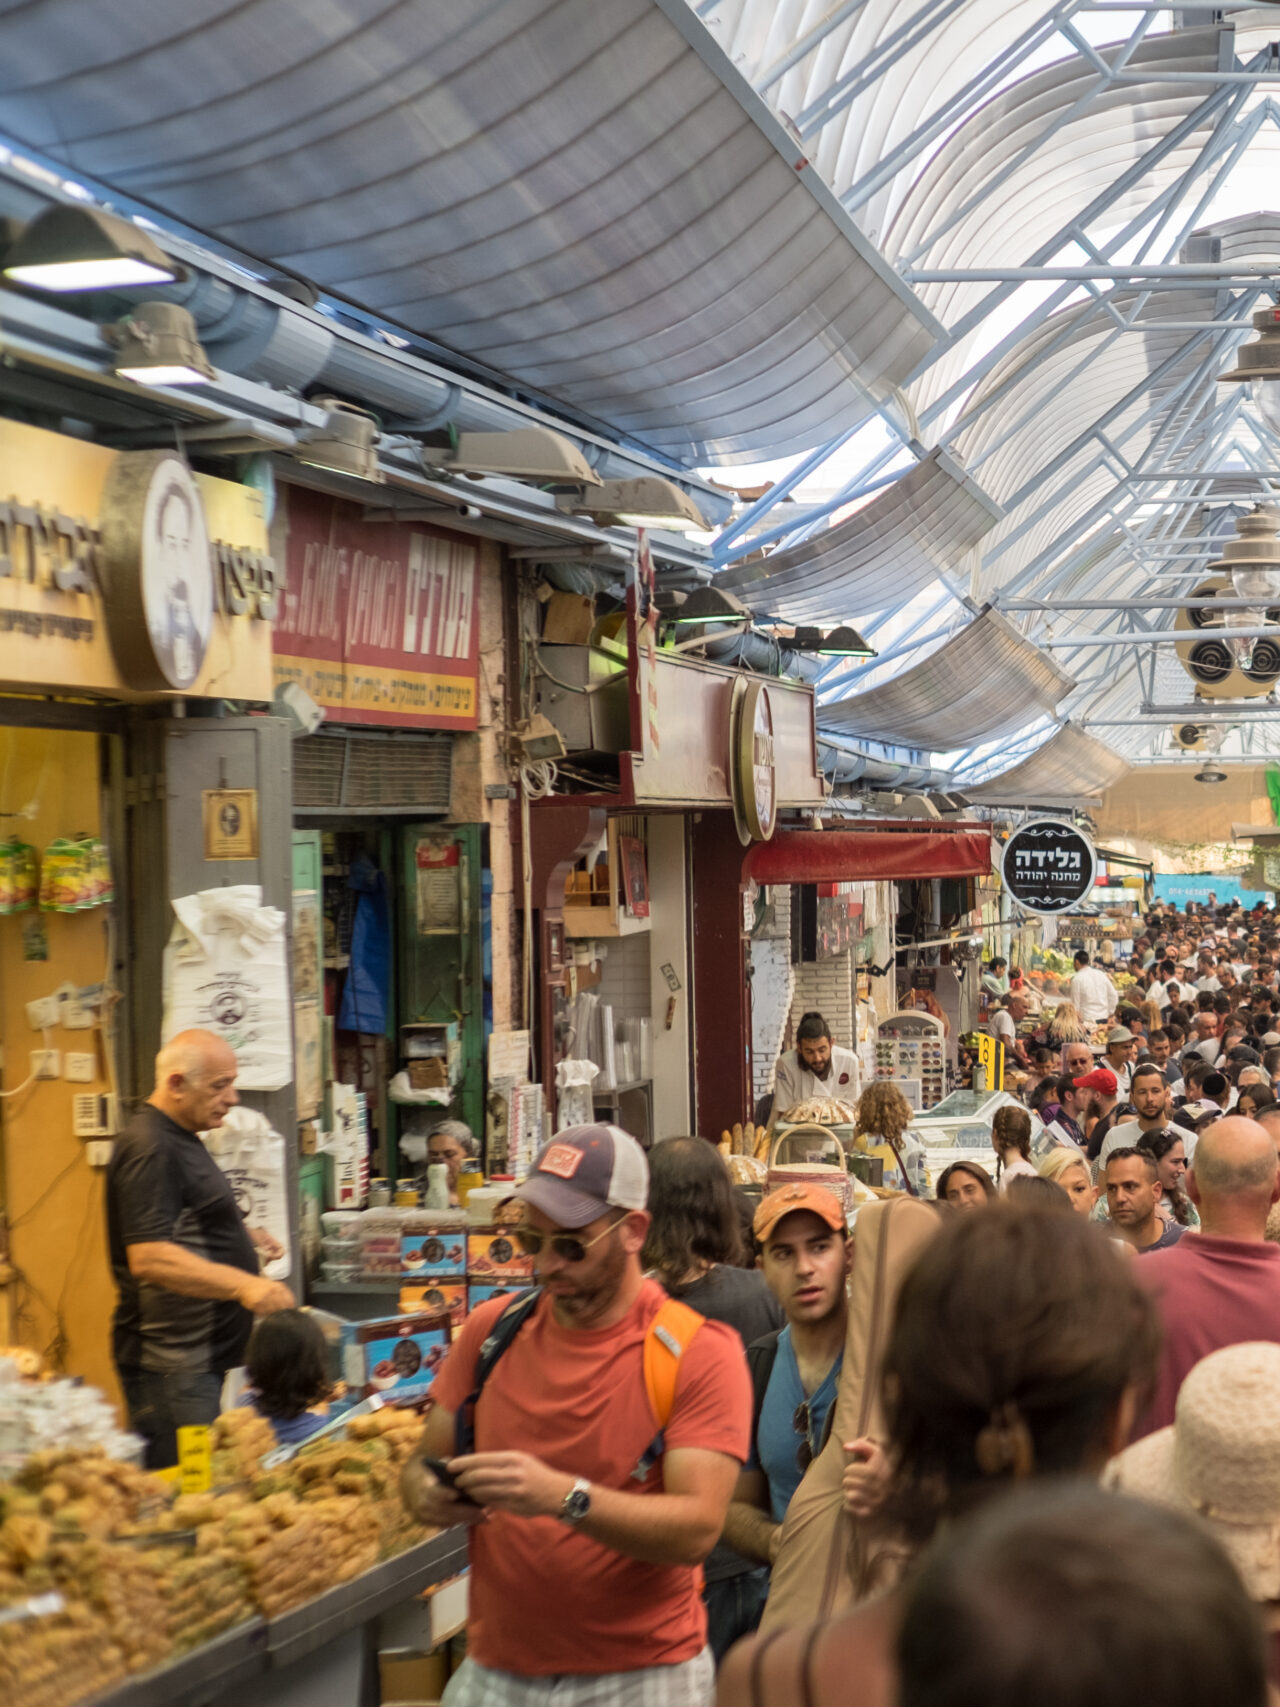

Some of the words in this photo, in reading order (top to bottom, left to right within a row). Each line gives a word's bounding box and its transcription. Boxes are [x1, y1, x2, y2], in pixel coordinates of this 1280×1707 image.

[1015, 847, 1081, 868] גלידה
[1016, 870, 1048, 881] יהודה
[1050, 871, 1081, 882] מחנה
